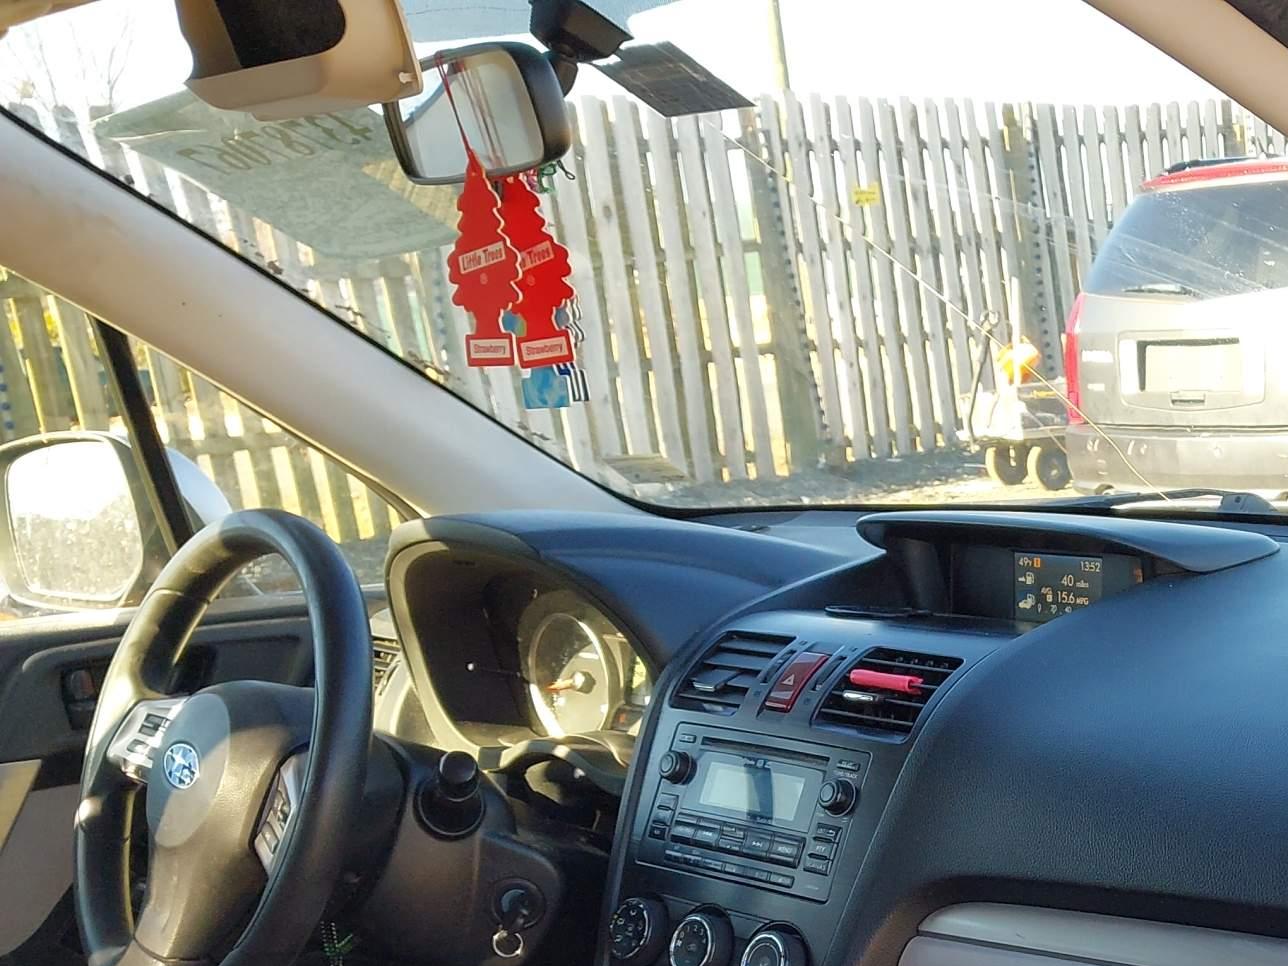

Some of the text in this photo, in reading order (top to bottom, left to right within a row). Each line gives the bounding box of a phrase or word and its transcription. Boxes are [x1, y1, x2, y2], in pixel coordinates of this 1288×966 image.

[461, 252, 482, 271] Little
[483, 247, 503, 264] Trees
[526, 247, 551, 265] Trees
[1061, 574, 1073, 586] 40
[1057, 591, 1075, 604] 15.6
